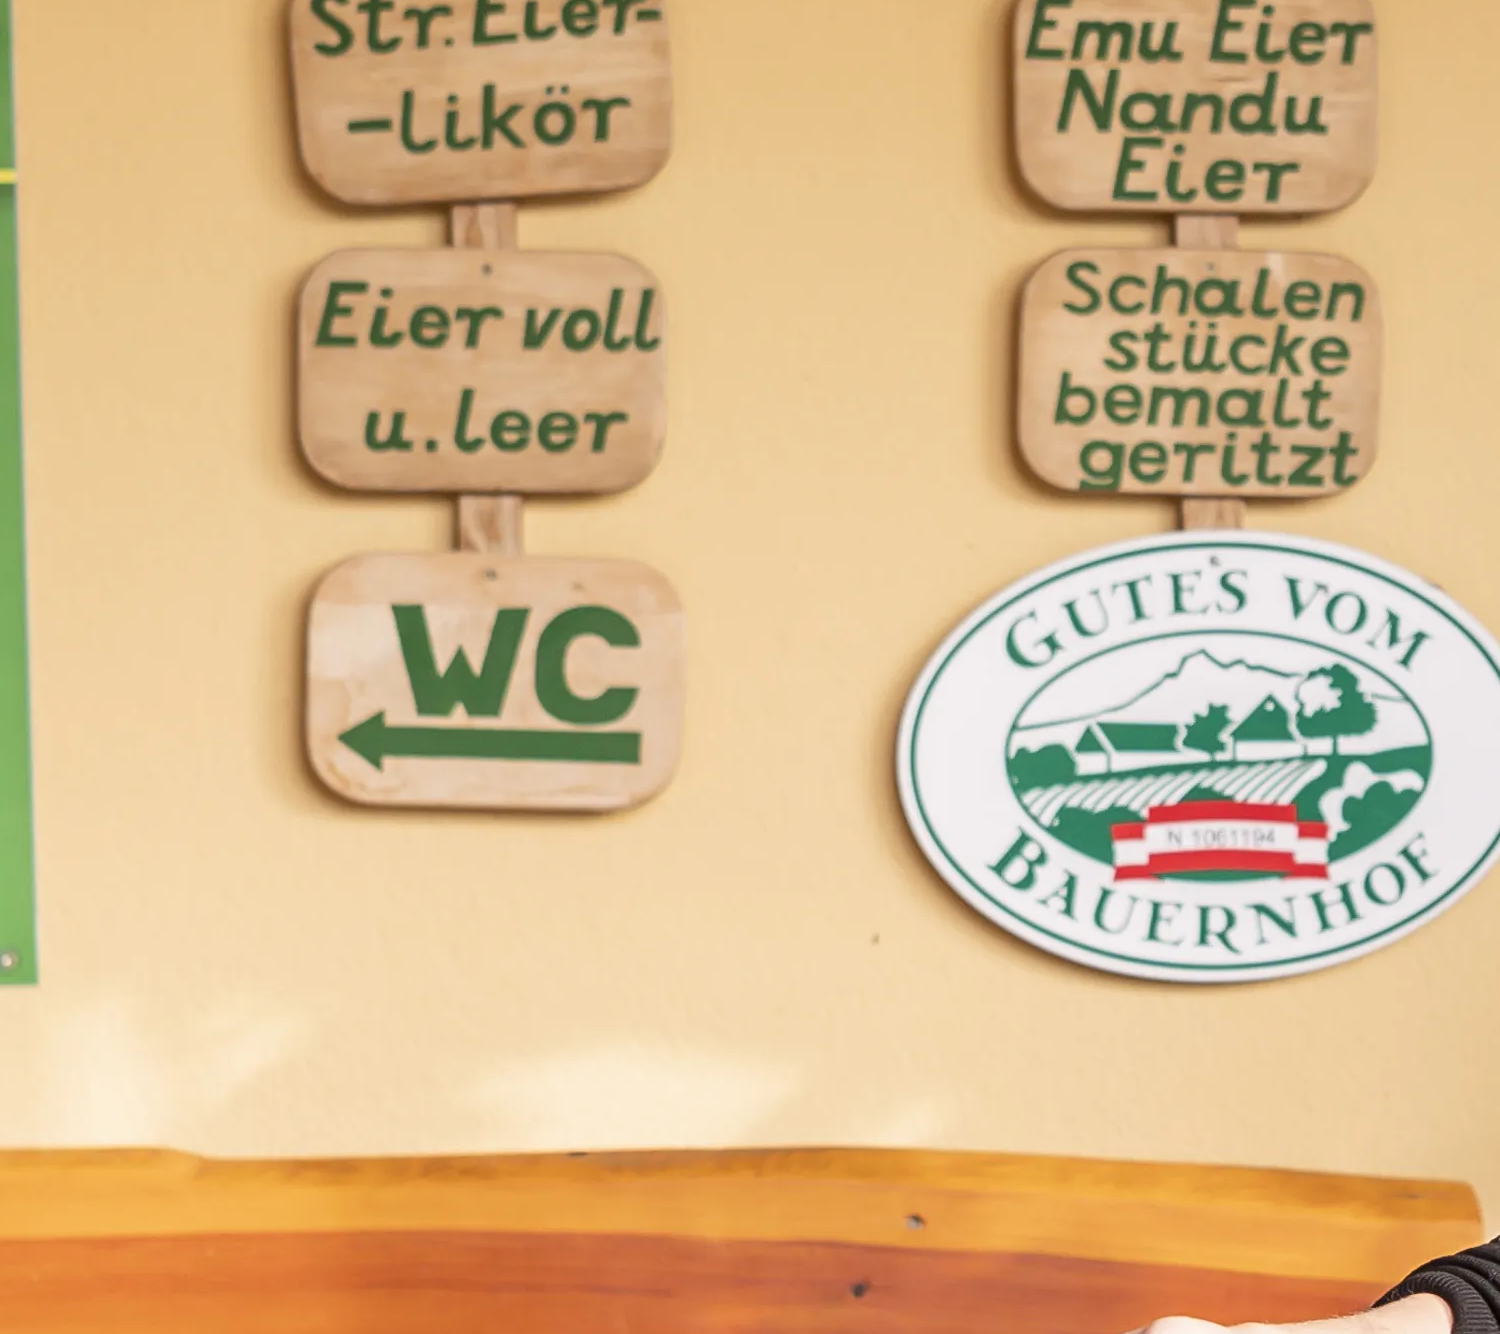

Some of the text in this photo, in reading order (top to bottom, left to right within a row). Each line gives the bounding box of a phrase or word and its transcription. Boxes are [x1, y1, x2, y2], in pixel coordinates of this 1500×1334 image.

[346, 83, 631, 155] -likör
[1055, 68, 1330, 135] Nandu
[1111, 136, 1300, 203] Eier
[314, 280, 662, 353] Eier voll
[1060, 260, 1366, 323] Schalen
[1102, 322, 1351, 378] stücke
[1053, 370, 1336, 432] bemalt
[1078, 431, 1358, 492] geritzt
[1283, 572, 1432, 671] VOM
[390, 603, 642, 726] WC
[987, 825, 1441, 955] BAUERNHOF
